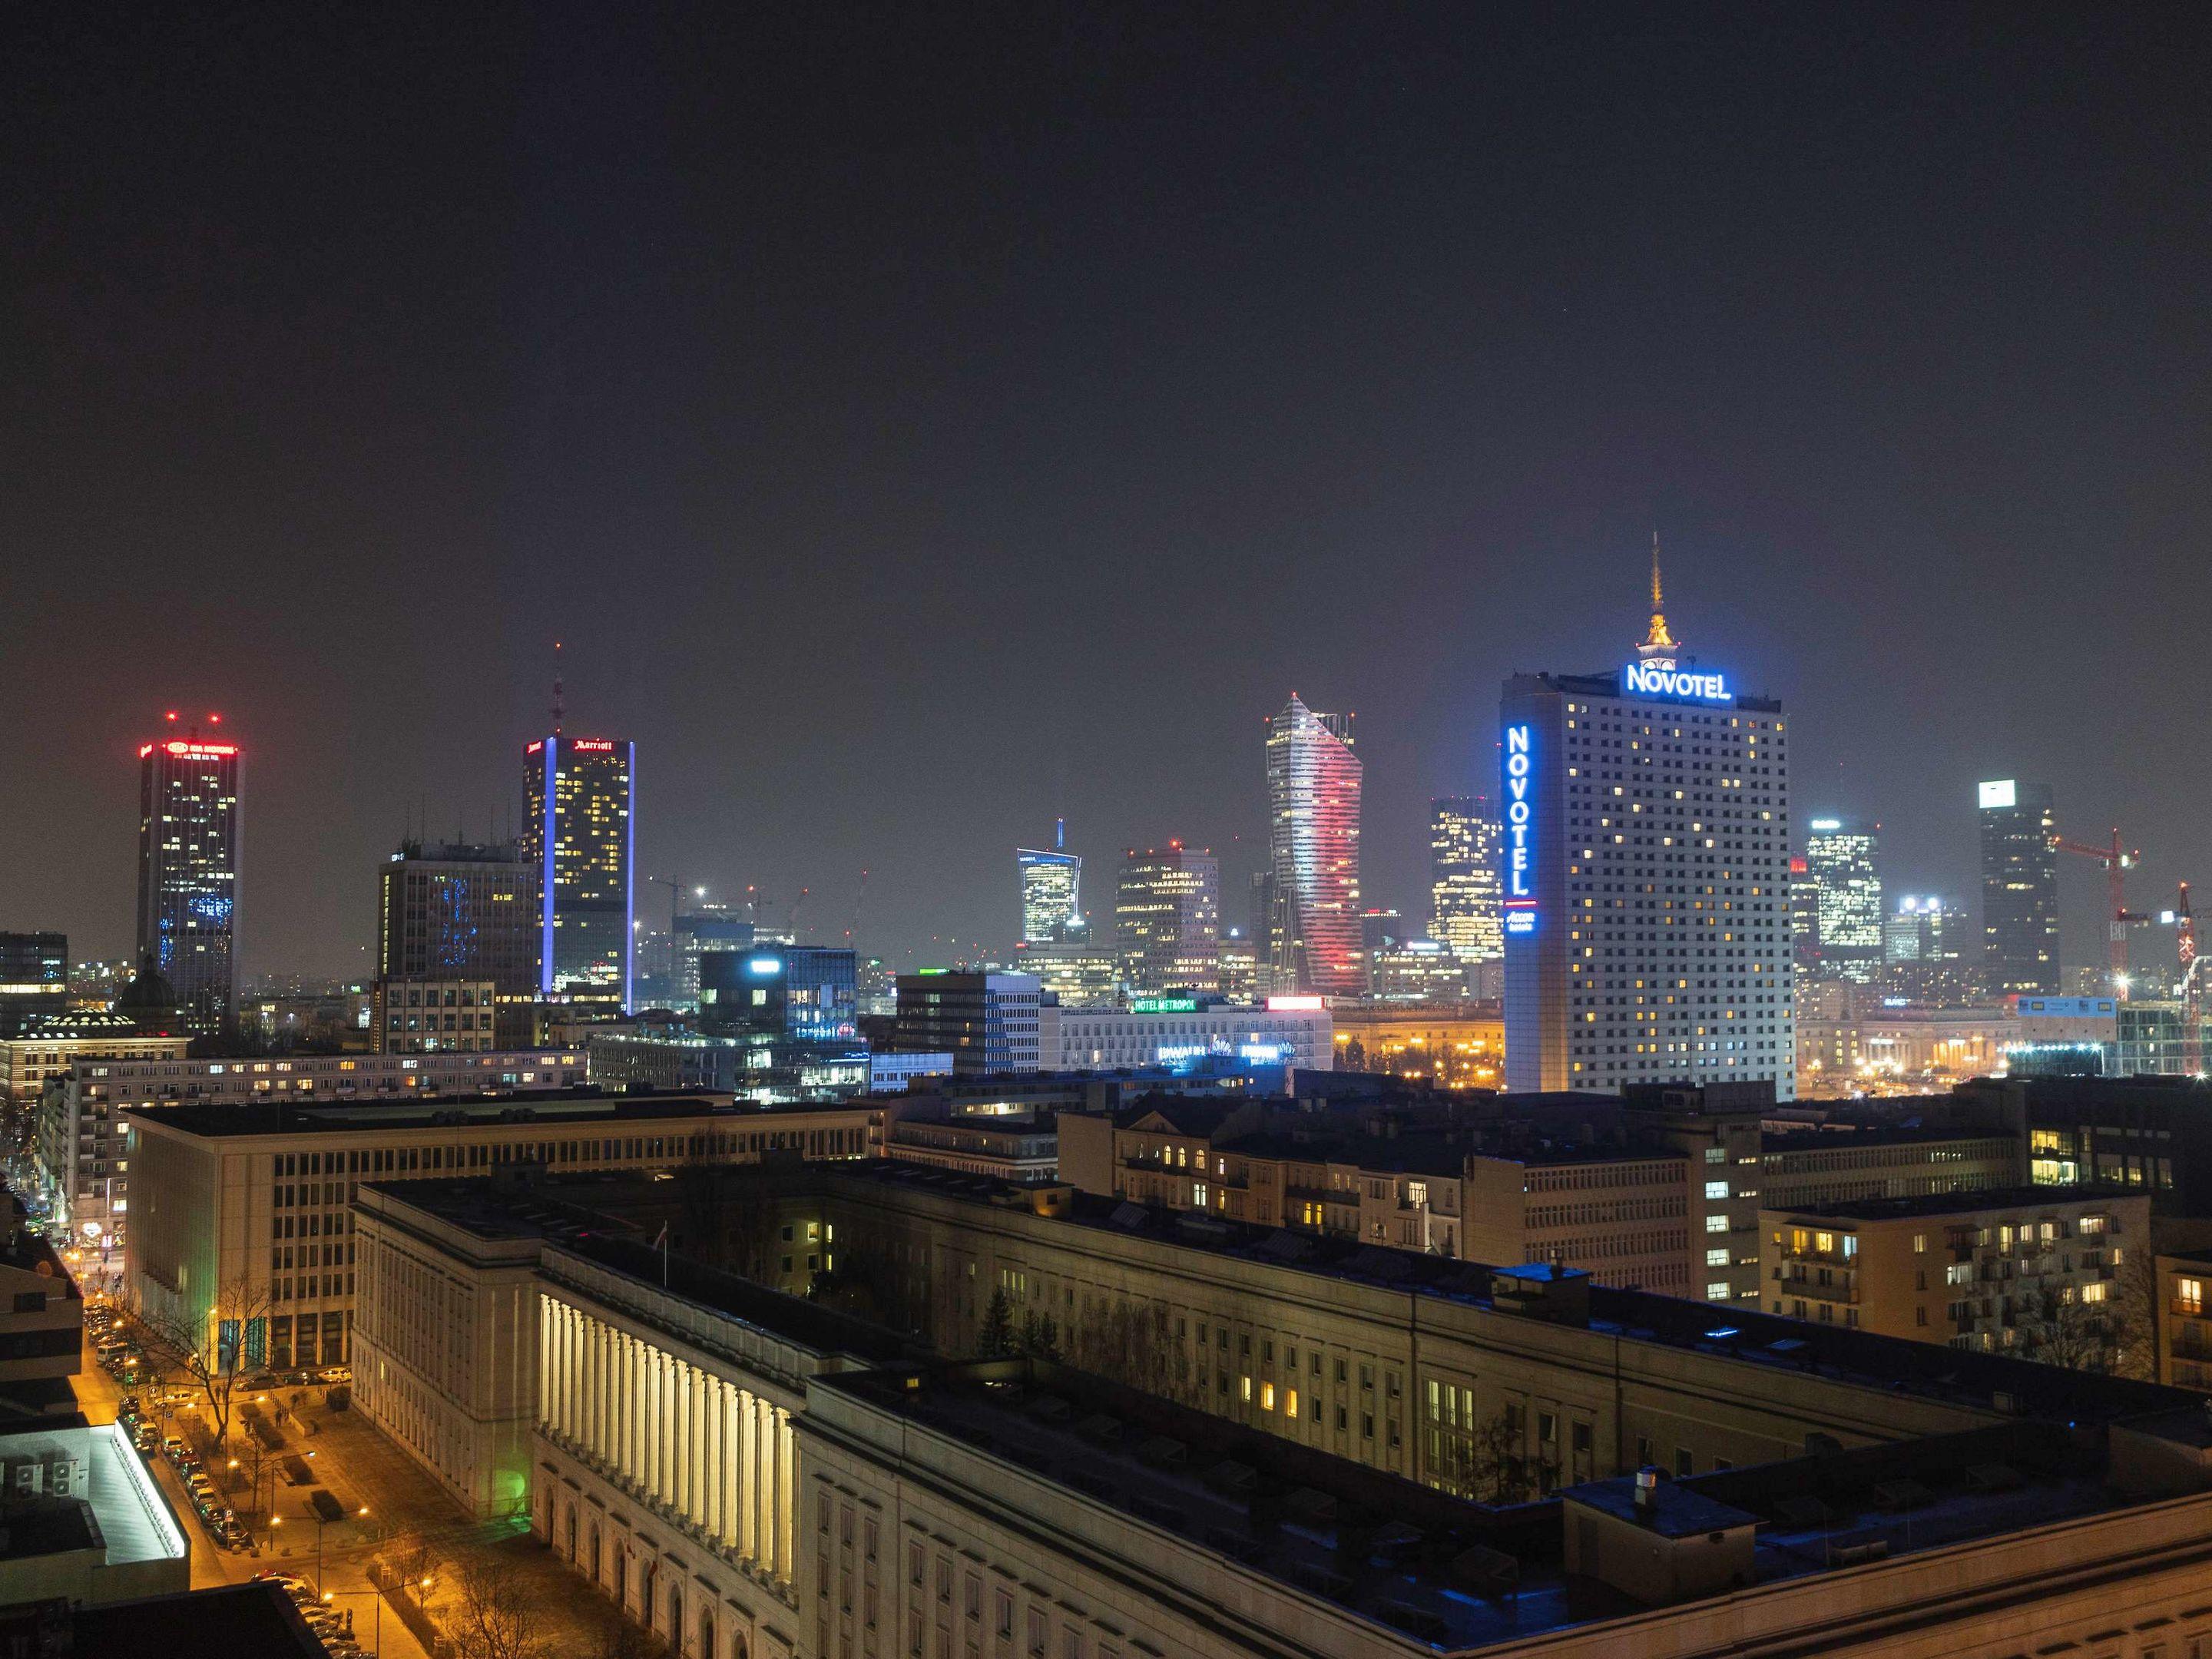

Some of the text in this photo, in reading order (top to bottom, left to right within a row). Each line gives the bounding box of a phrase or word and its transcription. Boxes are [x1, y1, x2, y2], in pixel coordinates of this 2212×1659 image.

[1628, 664, 1731, 700] NOVOTEL
[1508, 726, 1529, 895] NOVOTEL
[1157, 999, 1196, 1011] METROPOL
